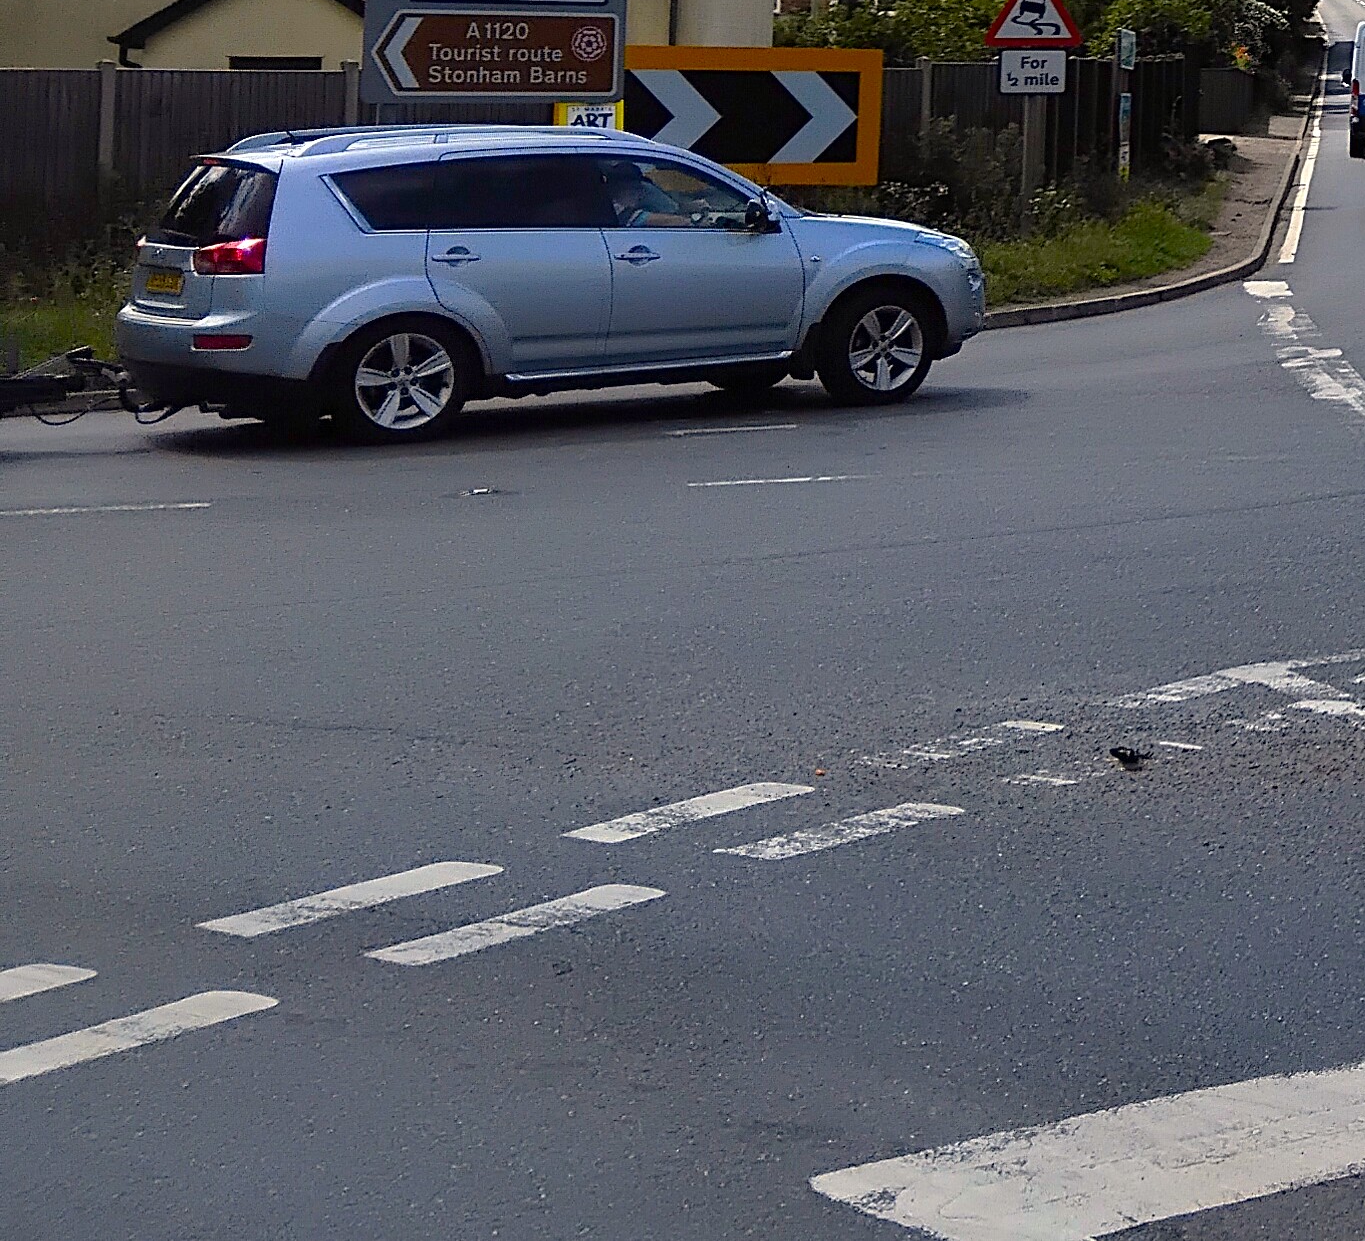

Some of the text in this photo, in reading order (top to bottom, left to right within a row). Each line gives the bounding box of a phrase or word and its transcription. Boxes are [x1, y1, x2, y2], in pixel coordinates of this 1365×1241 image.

[466, 21, 529, 40] A1120
[428, 43, 563, 62] Tourist route
[1020, 56, 1048, 69] For
[428, 65, 588, 84] Stonham Barns
[1024, 72, 1060, 86] mile
[570, 112, 613, 129] ART
